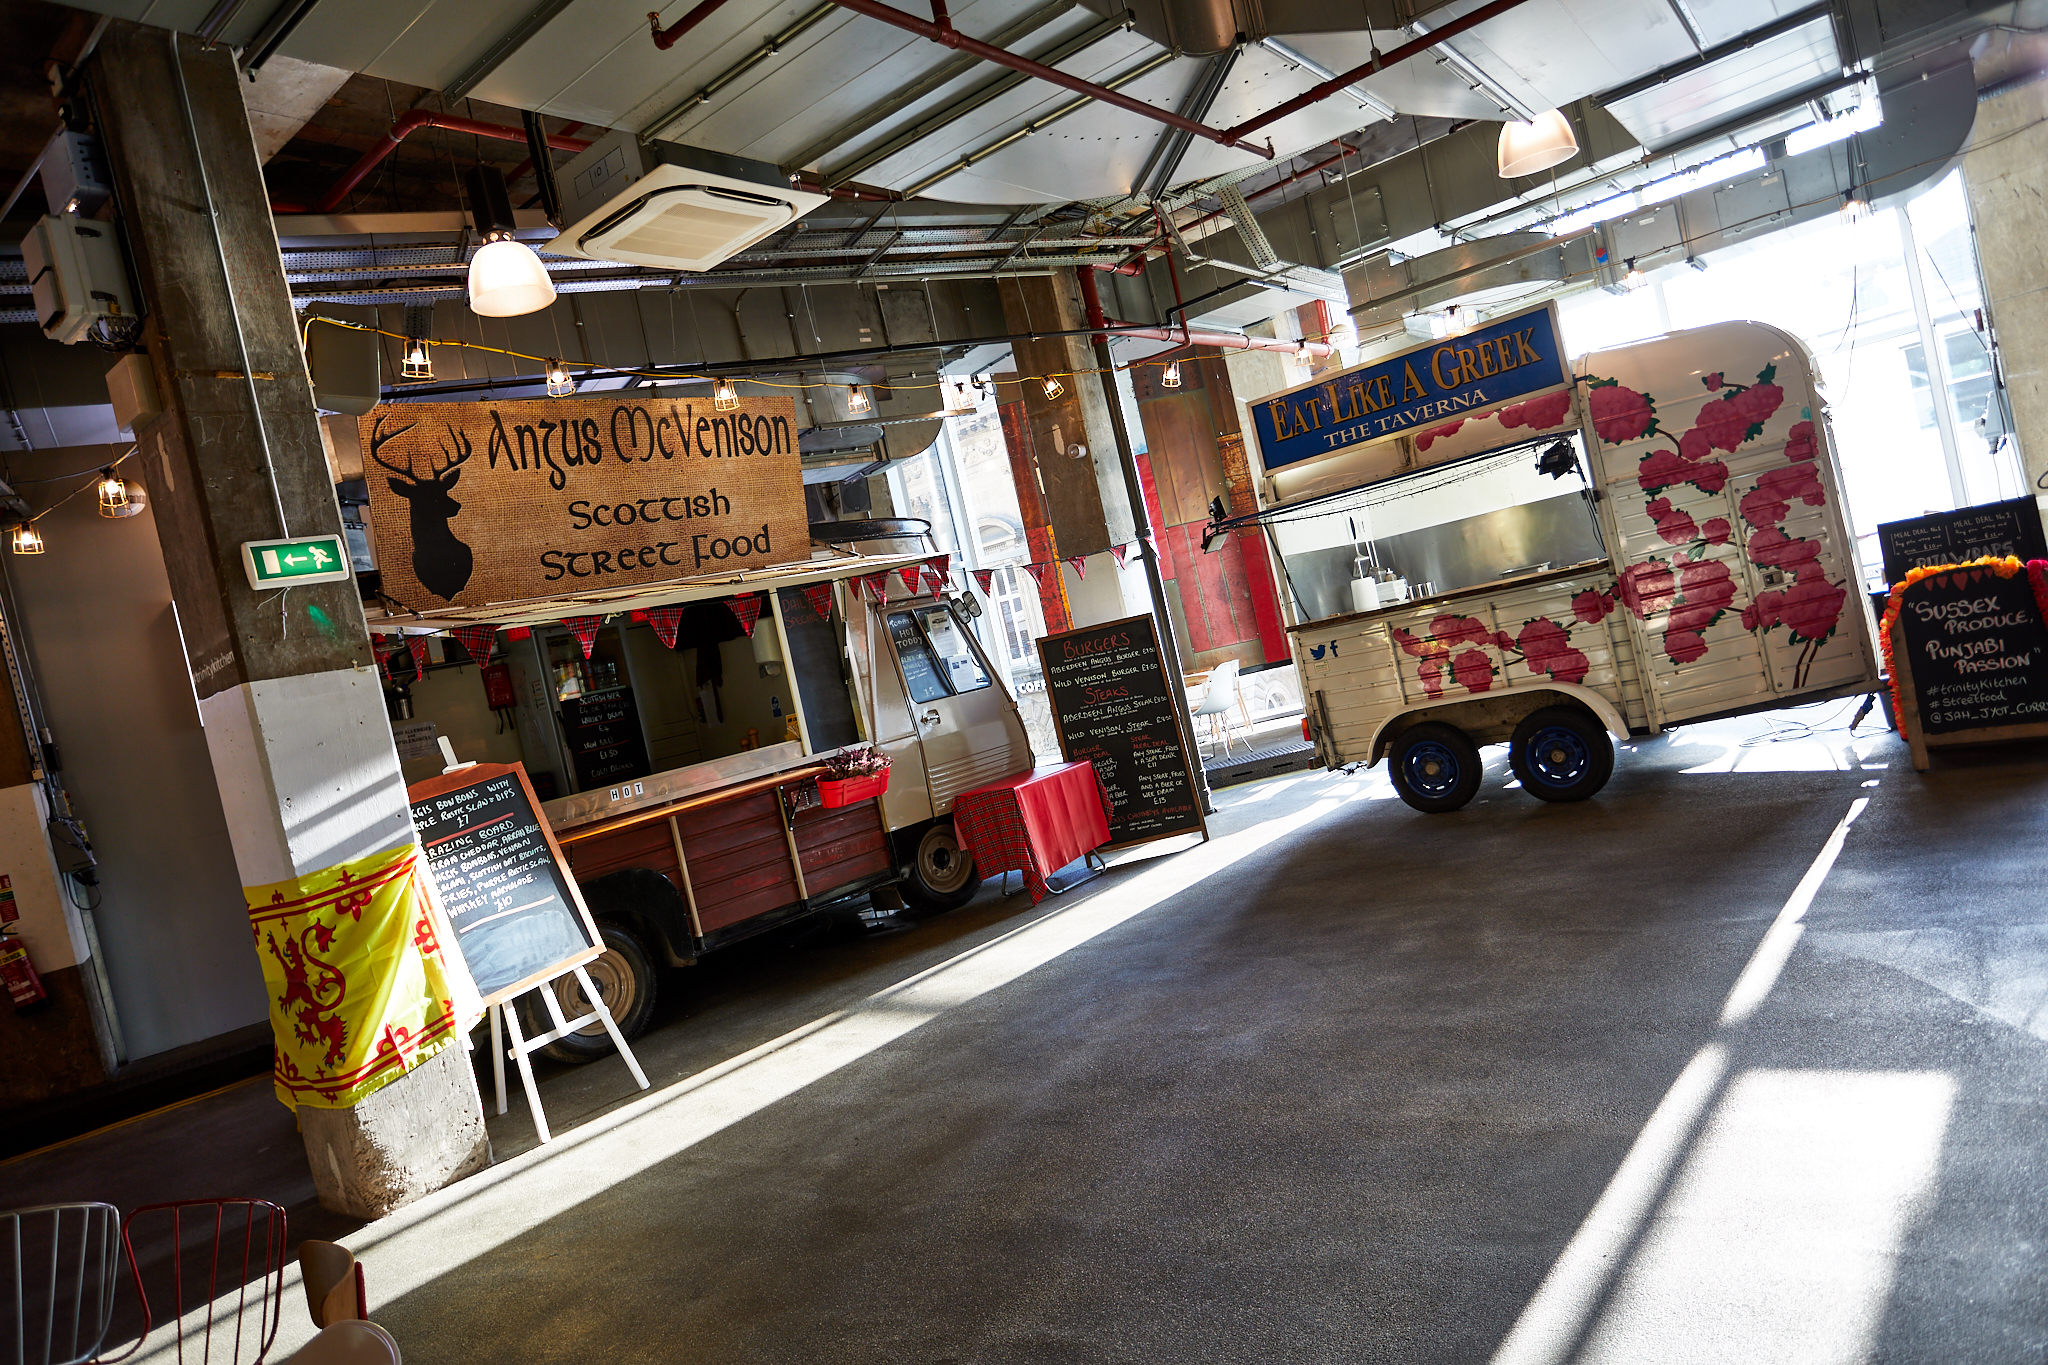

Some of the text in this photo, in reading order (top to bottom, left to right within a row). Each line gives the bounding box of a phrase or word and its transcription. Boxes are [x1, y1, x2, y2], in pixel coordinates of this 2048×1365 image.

[1268, 327, 1543, 442] EAT LIKE A GREEK
[1324, 389, 1490, 448] THE TAVERNA
[1954, 519, 1973, 528] MEAL
[1975, 516, 1994, 524] DEAL
[1894, 531, 1912, 539] MEAL
[899, 627, 914, 638] HOT
[896, 636, 923, 649] TODDY
[1063, 632, 1130, 659] BURGERS
[1925, 638, 2004, 660] PUNJABI
[1051, 661, 1087, 675] ABERDEEN
[1090, 656, 1112, 666] ANGUS
[1116, 650, 1141, 661] BURGER
[1054, 680, 1072, 689] WILD
[1074, 672, 1107, 685] VENISON
[1111, 666, 1140, 677] BURGER
[1083, 686, 1129, 704] STEAKS
[1063, 708, 1103, 724] ABERDEEN
[1107, 703, 1131, 714] ANGUS
[1133, 698, 1154, 709] STEAK
[1930, 702, 2048, 723] @JAH_JYOT_CURR
[1067, 731, 1085, 741] WILD
[1089, 724, 1121, 736] VENISON
[1126, 720, 1153, 730] STEAK
[1130, 734, 1152, 743] STEAK
[1073, 744, 1102, 757] BURGER
[591, 768, 608, 778] COLD
[487, 779, 509, 792] WITH
[1156, 788, 1175, 796] DRAM
[466, 799, 488, 813] SLAW
[495, 788, 516, 801] DIPS
[1154, 797, 1166, 805] £13
[457, 814, 469, 828] £7
[424, 820, 514, 859] RAZING BOARD
[499, 838, 530, 856] VENISON
[476, 873, 508, 892] PURPLE
[494, 896, 513, 912] £10
